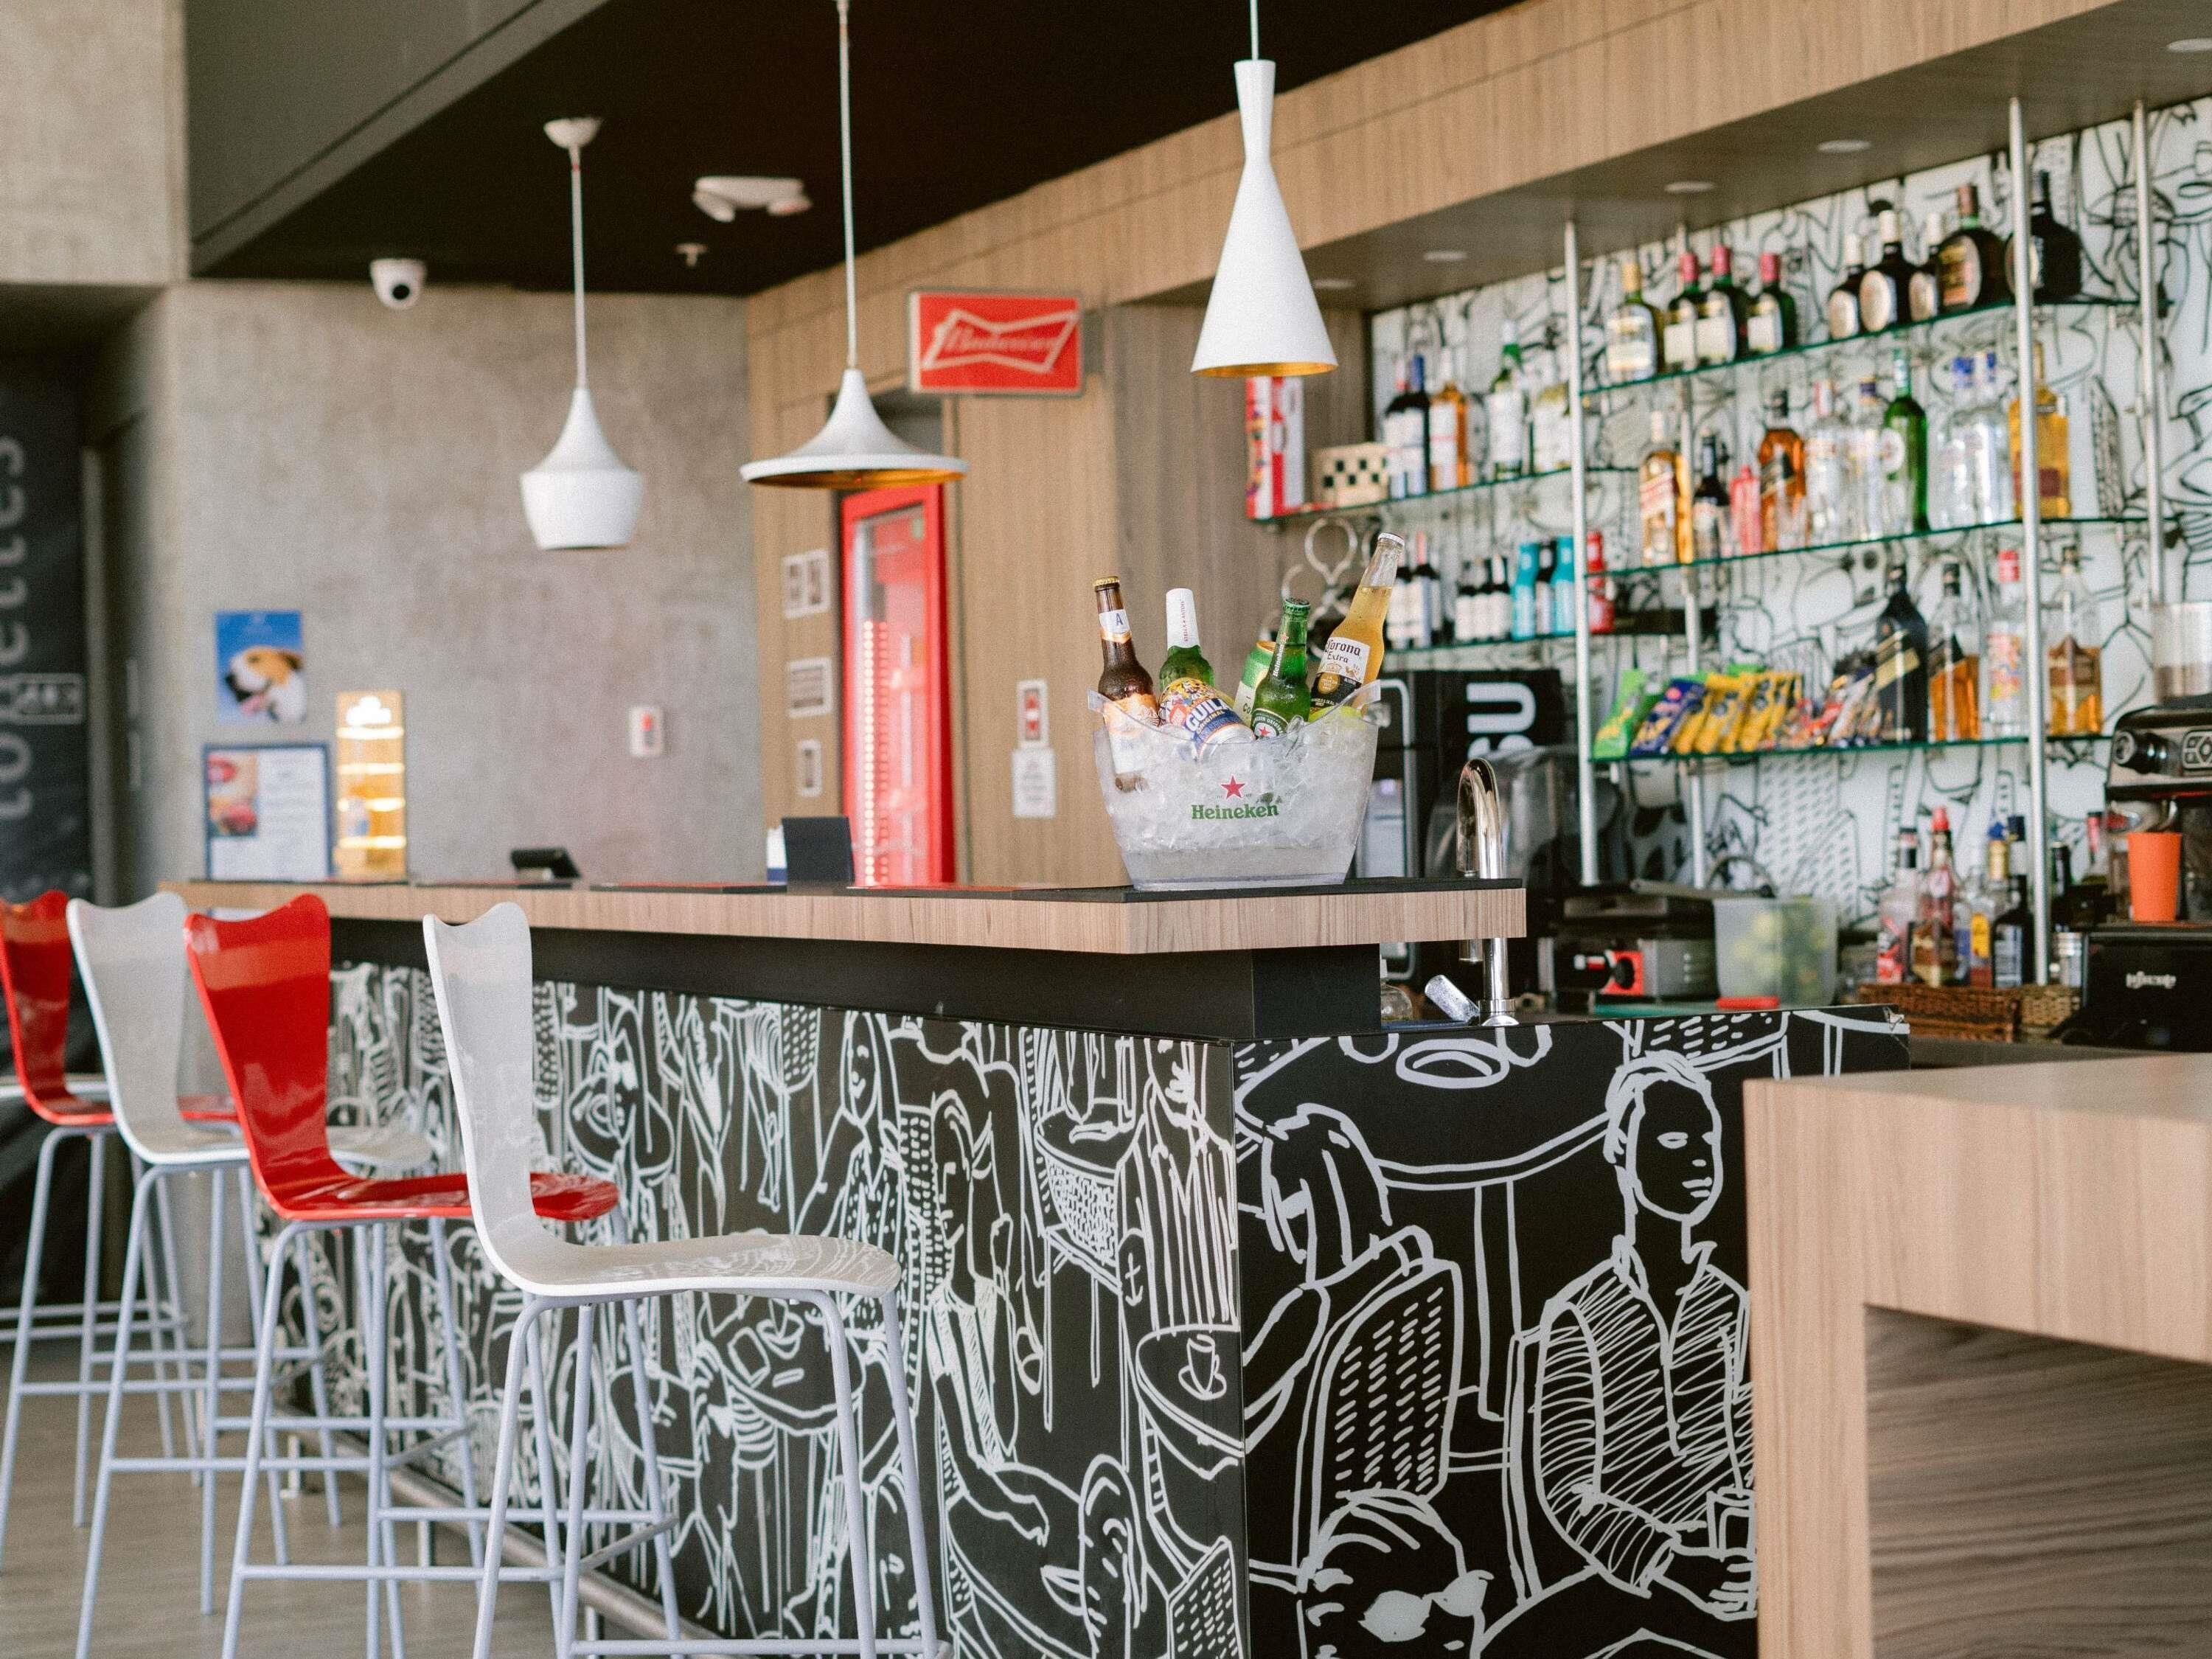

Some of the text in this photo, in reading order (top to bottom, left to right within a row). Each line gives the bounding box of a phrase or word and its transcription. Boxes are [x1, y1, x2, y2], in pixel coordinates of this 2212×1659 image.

[1272, 644, 1284, 678] Heineken
[1326, 650, 1349, 663] Extra
[1191, 803, 1279, 820] Heineken
